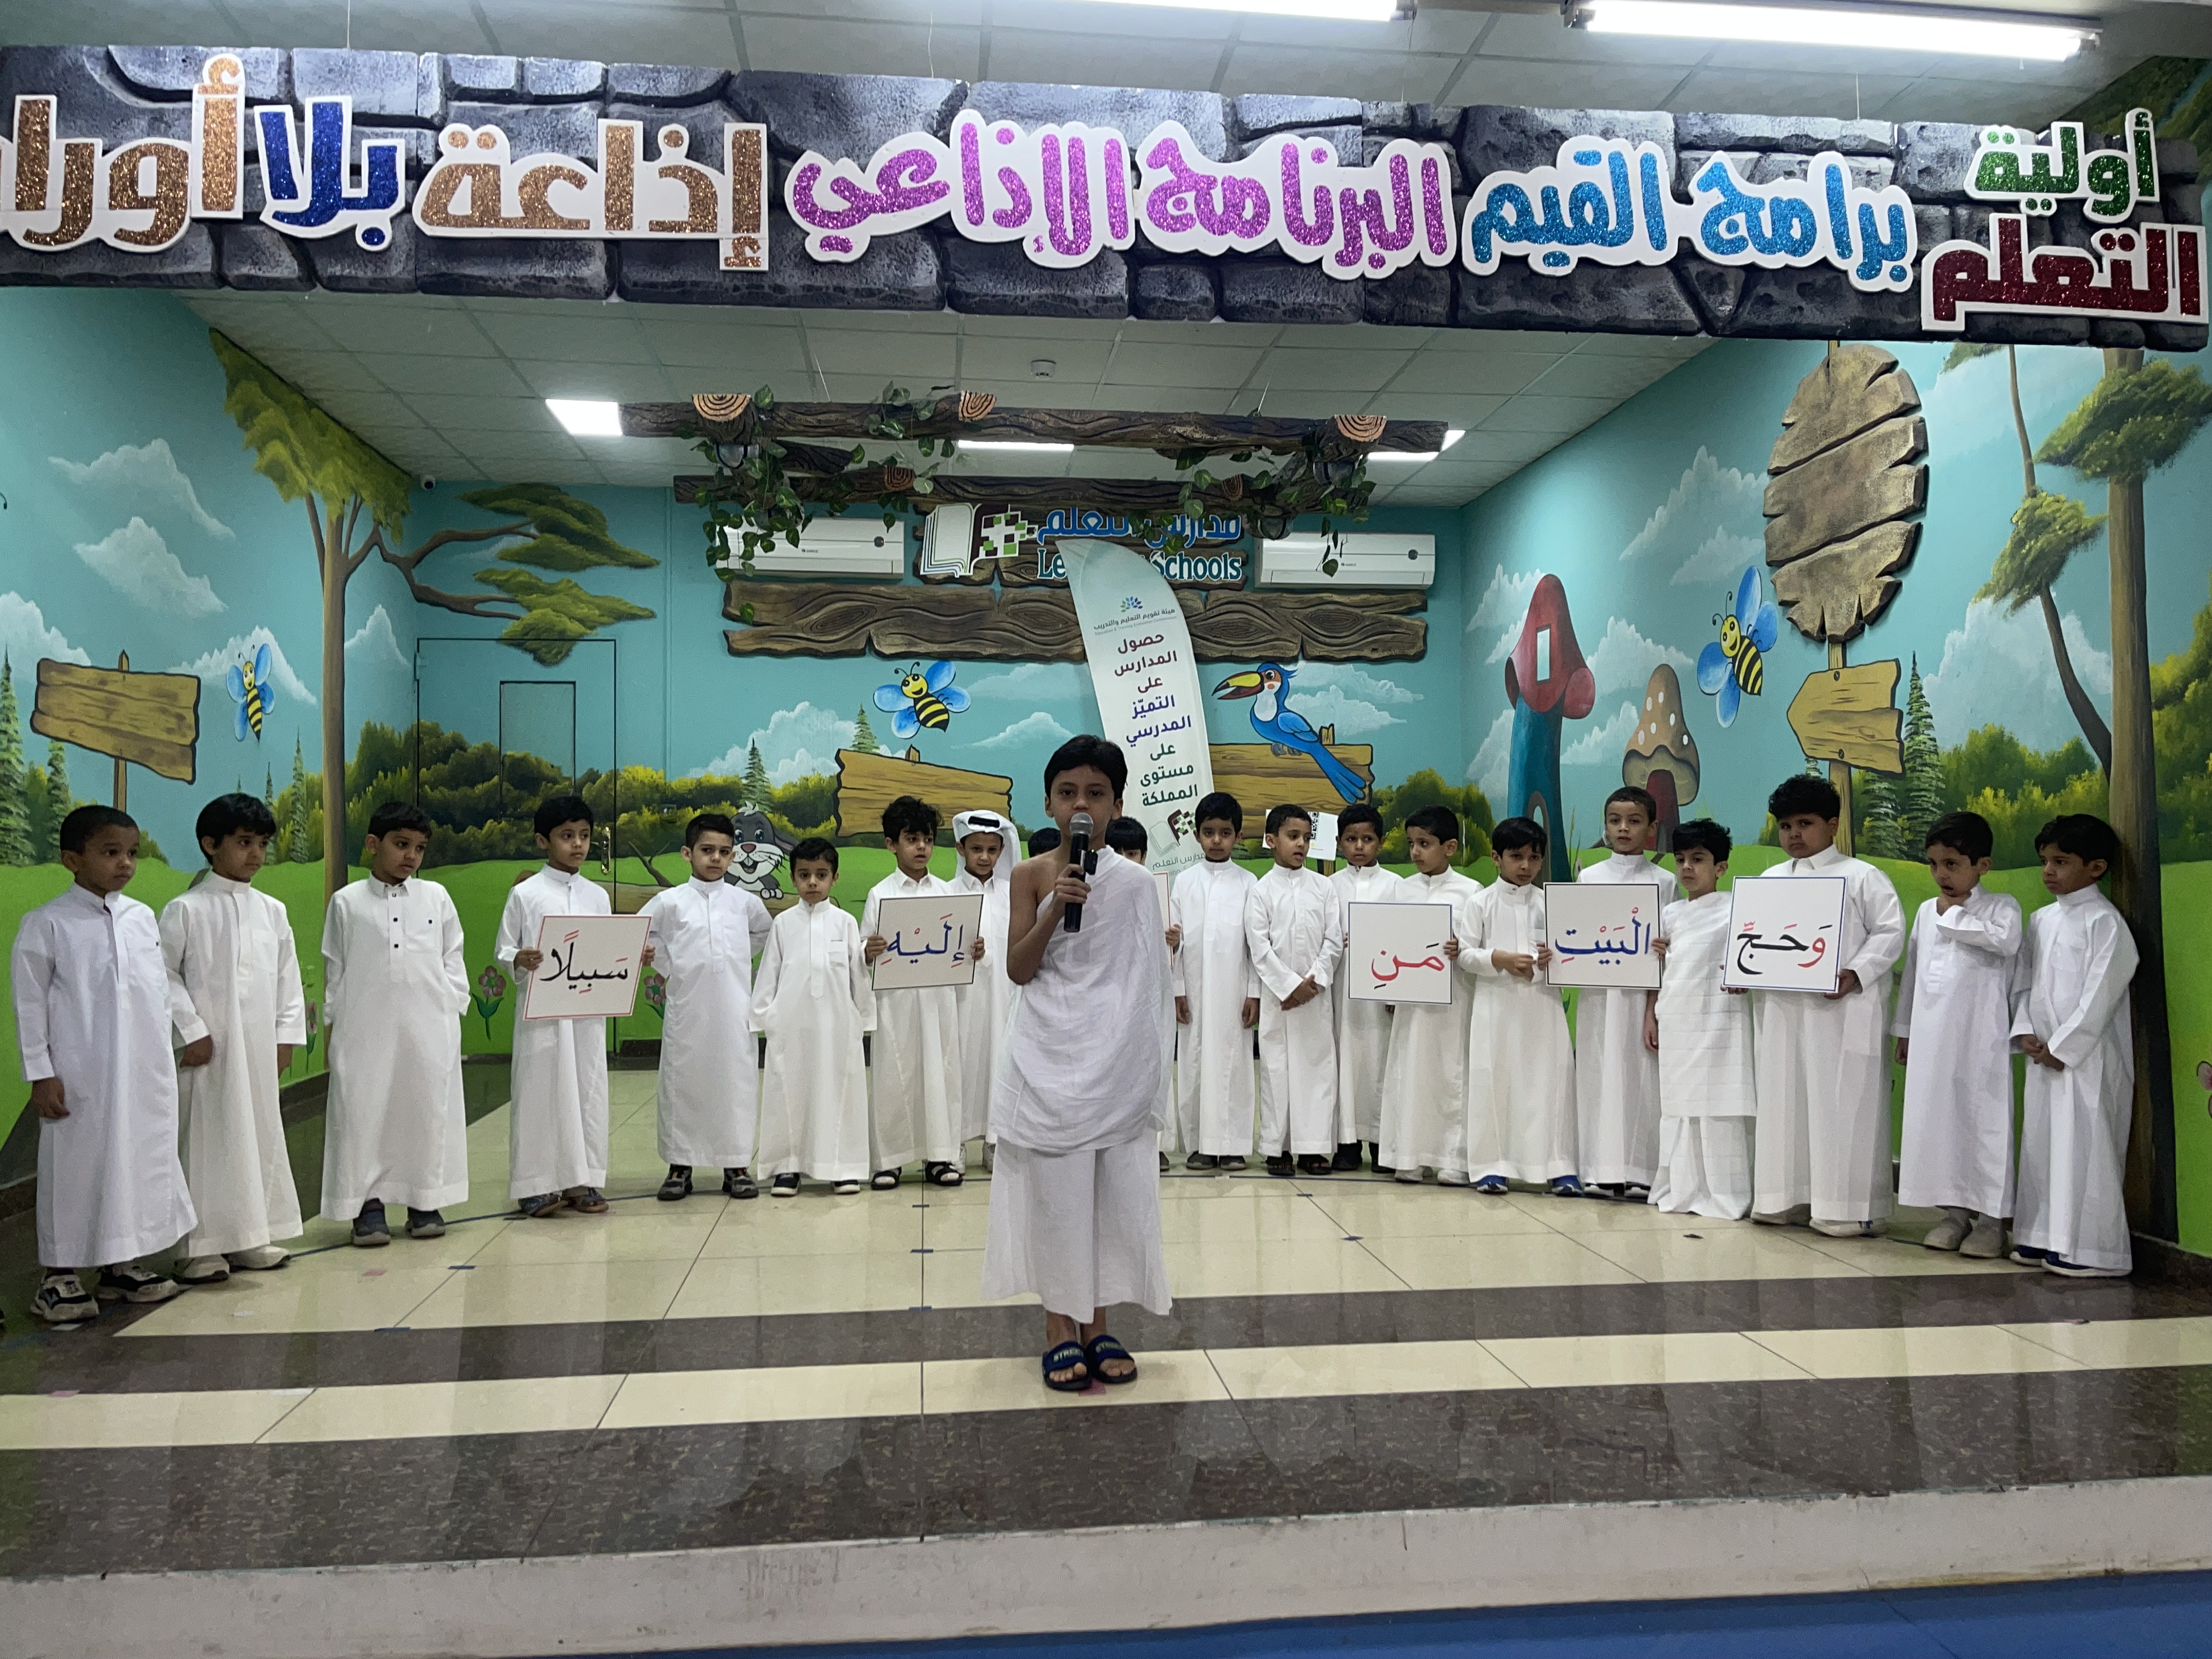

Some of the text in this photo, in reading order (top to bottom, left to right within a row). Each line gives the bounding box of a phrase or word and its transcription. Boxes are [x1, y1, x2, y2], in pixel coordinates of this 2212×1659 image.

[0, 57, 763, 268] إذاعة بلا أورا
[1974, 111, 2154, 216] أولية
[793, 122, 1447, 269] البرنامج الإذاعي
[1472, 150, 1908, 283] برامج القيم
[1933, 218, 2202, 321] التعلم
[1150, 550, 1242, 581] Schools
[1093, 619, 1119, 630] والتدريب
[1120, 614, 1141, 625] التعليم
[1142, 610, 1160, 620] تقويم
[1118, 632, 1165, 654] حصول
[1114, 650, 1177, 676] المدارس
[1137, 676, 1163, 693] على
[1126, 715, 1192, 748] المدرسي
[1150, 743, 1176, 761] على
[1140, 764, 1194, 787] مستوى
[1142, 784, 1198, 806] المملكة
[1180, 853, 1205, 865] مدارس
